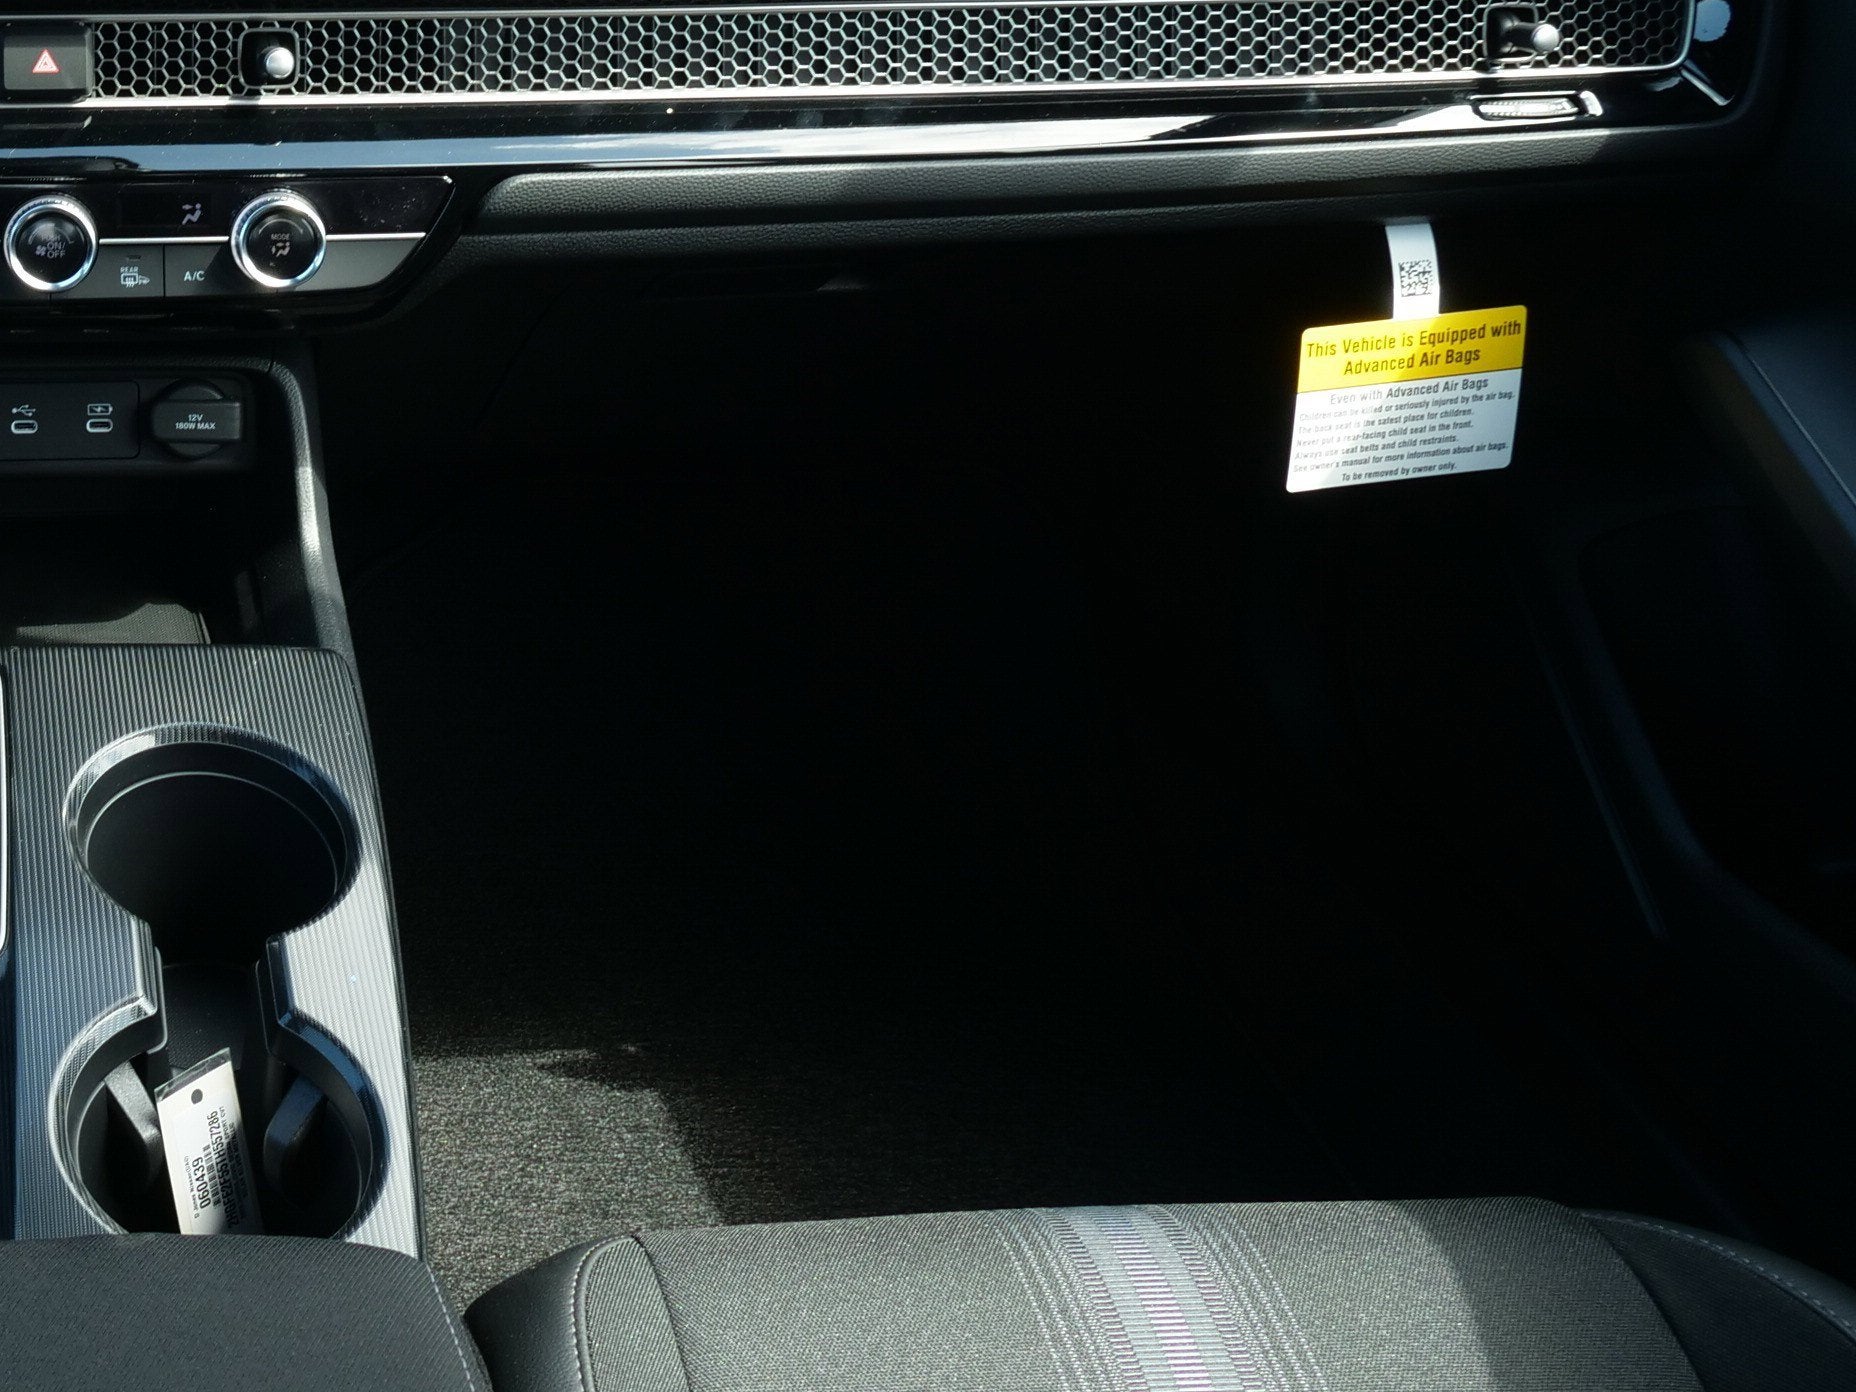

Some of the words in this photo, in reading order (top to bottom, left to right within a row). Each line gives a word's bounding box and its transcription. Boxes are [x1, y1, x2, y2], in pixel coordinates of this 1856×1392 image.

[270, 233, 291, 241] MODE
[46, 250, 66, 259] OFF
[120, 266, 140, 274] REAR
[183, 270, 206, 282] A/C
[1307, 340, 1337, 358] This
[1343, 334, 1396, 354] Vehicle
[1402, 332, 1414, 347] is
[1419, 323, 1487, 348] Equipped
[1490, 319, 1522, 338] with
[1343, 352, 1415, 376] Advanced
[1419, 350, 1442, 368] Air
[1444, 348, 1482, 366] Bags
[1330, 393, 1356, 405] Even
[1360, 389, 1383, 402] with
[1385, 381, 1440, 399] Advanced
[1442, 379, 1460, 393] Air
[1461, 377, 1489, 392] Bags
[1361, 404, 1383, 414] killed
[1384, 404, 1394, 413] or
[1395, 398, 1431, 412] seriously
[1431, 395, 1459, 409] injured
[1460, 393, 1470, 405] by
[1472, 393, 1484, 403] the
[1485, 391, 1497, 402] air
[174, 421, 196, 430] 180W
[196, 421, 217, 430] MAX
[187, 413, 204, 422] 12V
[1377, 415, 1402, 426] safest
[1403, 412, 1425, 424] place
[1427, 410, 1438, 421] for
[1440, 407, 1475, 419] children.
[1343, 430, 1387, 442] rear-facing
[1388, 426, 1408, 437] child
[1410, 424, 1427, 434] seat
[1428, 423, 1437, 432] in
[1438, 421, 1451, 432] the
[1359, 443, 1379, 453] belts
[1381, 441, 1396, 451] and
[1398, 438, 1417, 448] child
[1419, 434, 1459, 446] restraints.
[1341, 456, 1371, 467] manual
[1372, 454, 1384, 464] for
[1384, 452, 1405, 462] more
[1406, 447, 1451, 460] information
[1452, 444, 1474, 455] about
[1475, 442, 1487, 452] air
[1342, 472, 1351, 482] To
[1352, 471, 1363, 481] be
[1364, 467, 1399, 478] removed
[1400, 466, 1410, 477] by
[1412, 463, 1437, 473] owner
[192, 1156, 211, 1210] 060439
